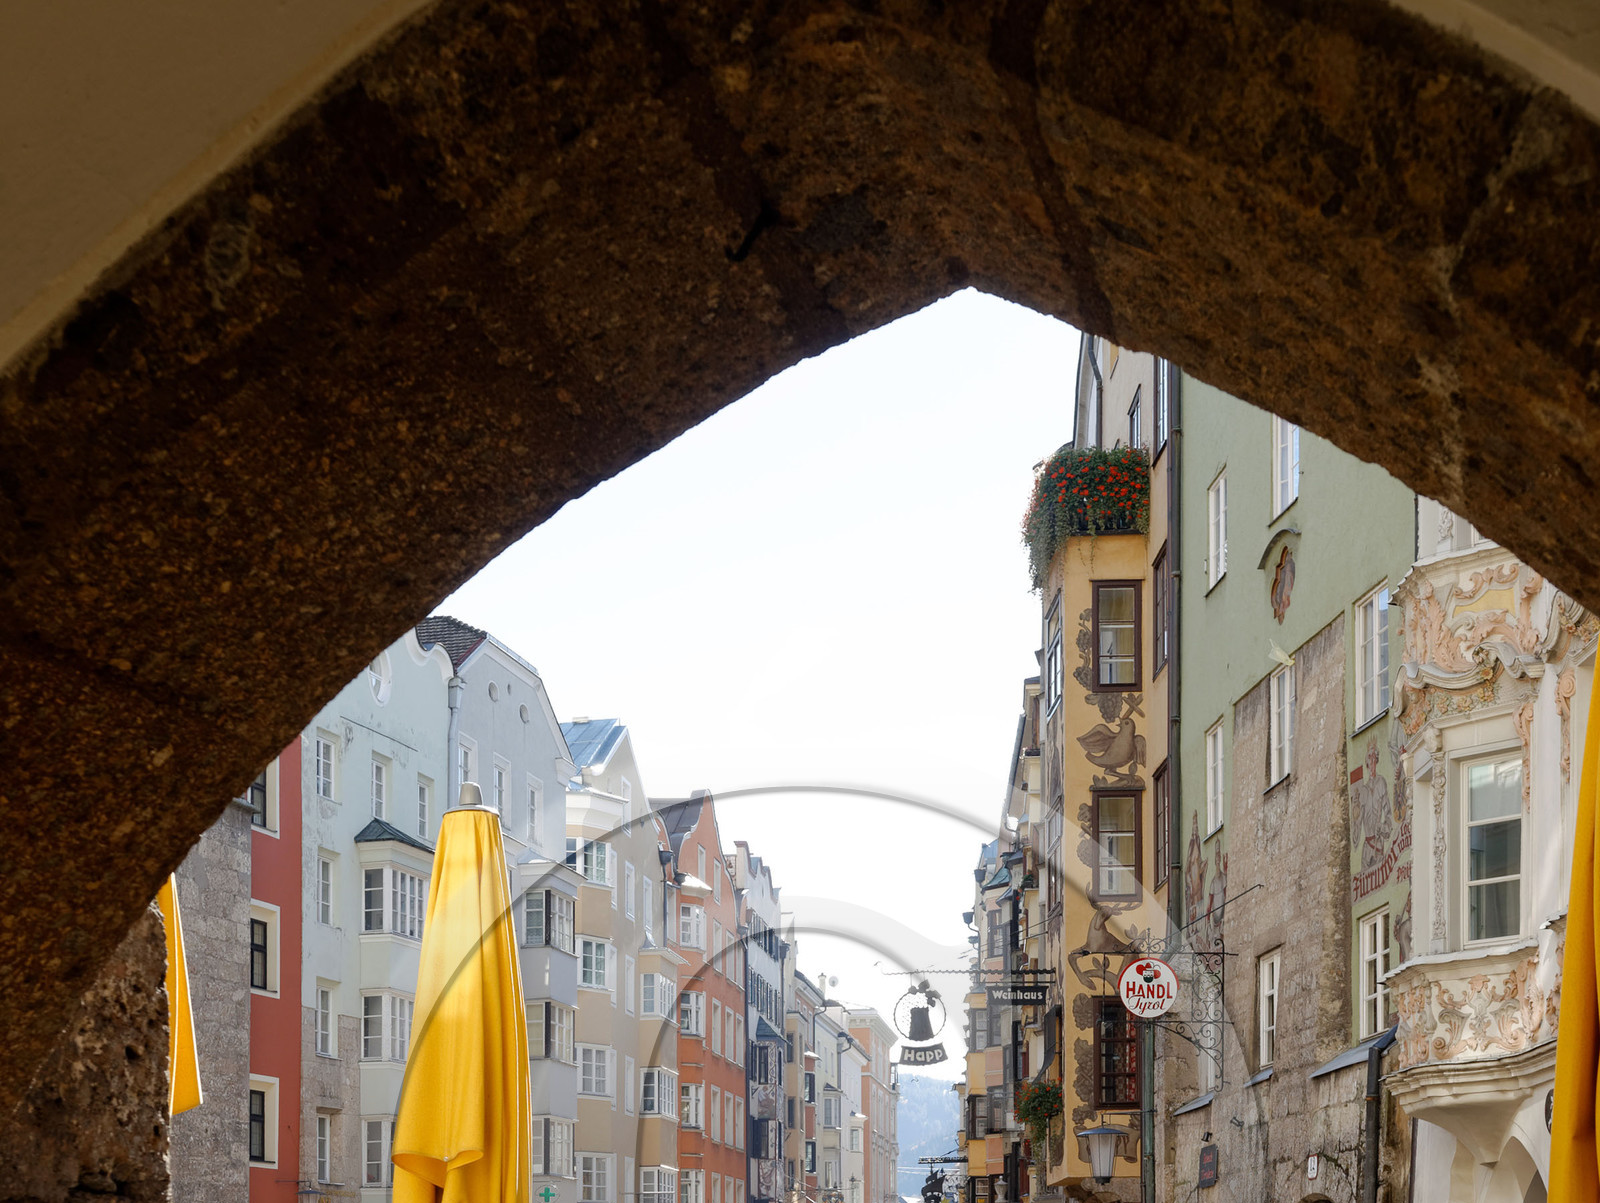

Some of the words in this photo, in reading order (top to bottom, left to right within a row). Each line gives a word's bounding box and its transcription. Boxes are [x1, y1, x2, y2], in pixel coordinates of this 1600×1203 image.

[991, 988, 1043, 1000] Weinhaus
[1126, 981, 1173, 999] HANDL
[1128, 994, 1166, 1015] Tyrol
[903, 1048, 944, 1062] Happ
